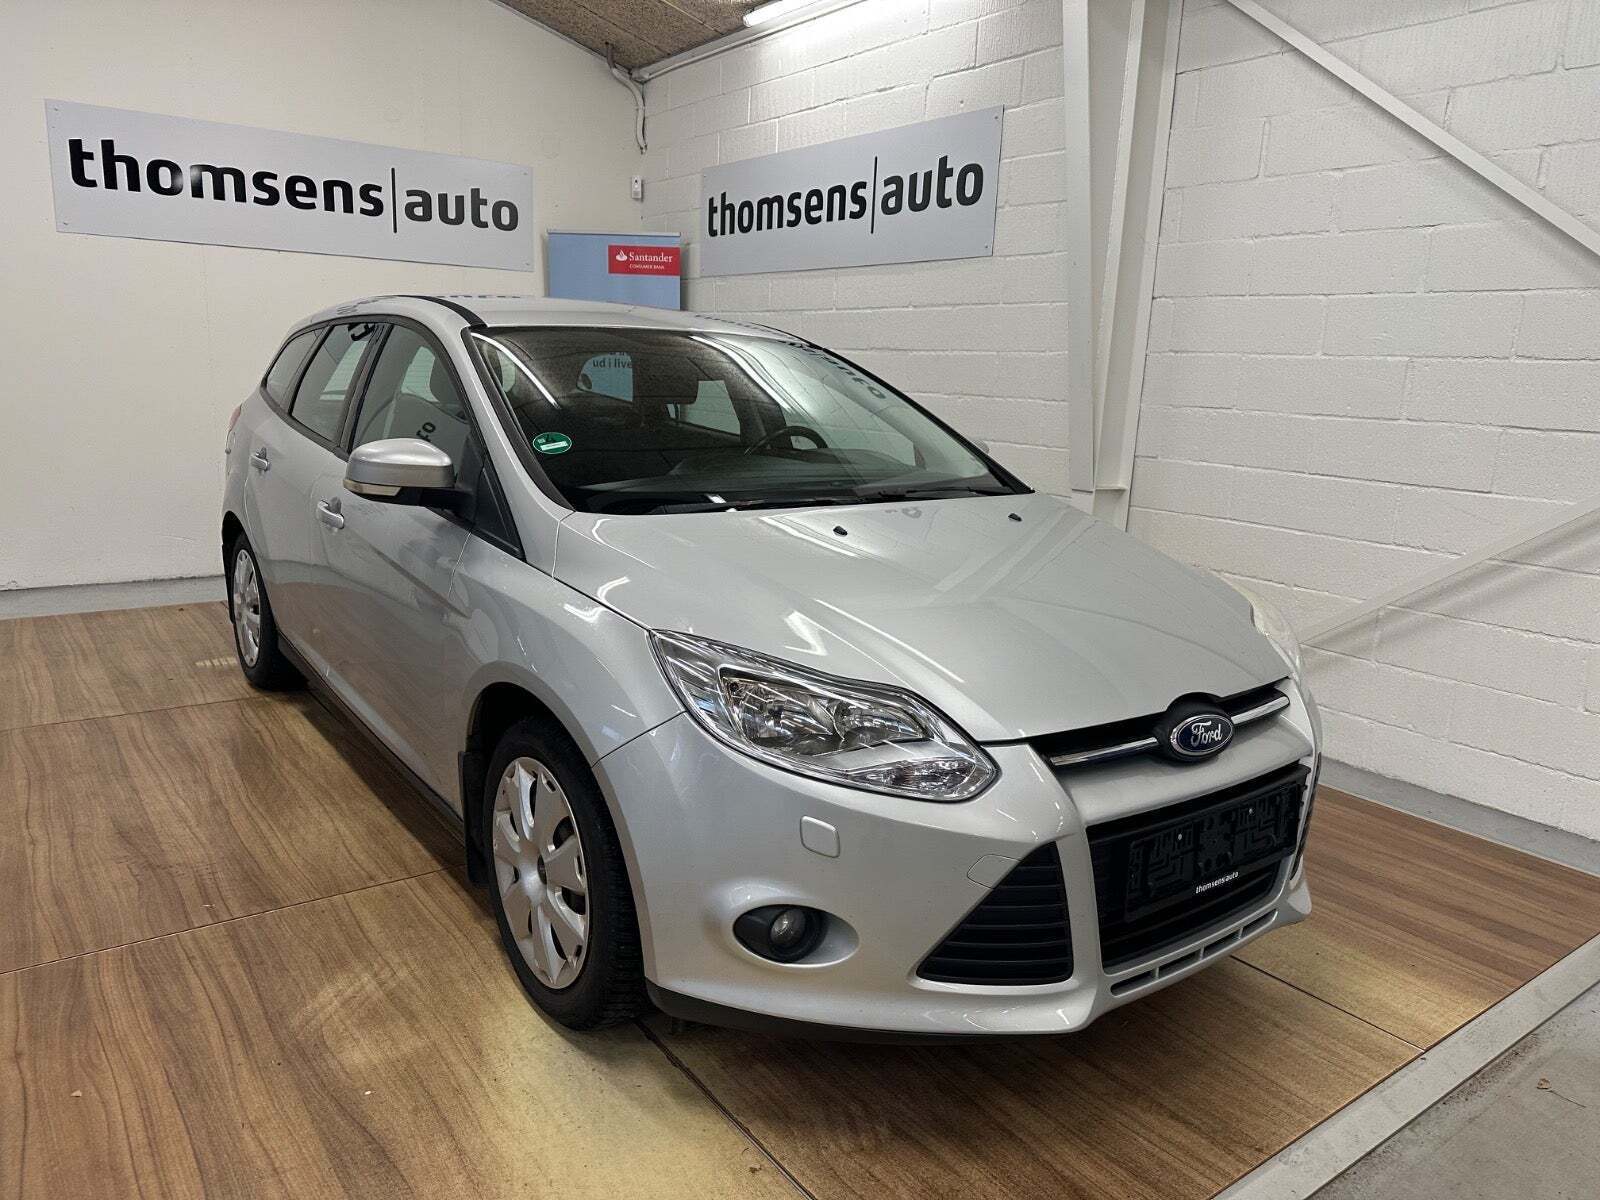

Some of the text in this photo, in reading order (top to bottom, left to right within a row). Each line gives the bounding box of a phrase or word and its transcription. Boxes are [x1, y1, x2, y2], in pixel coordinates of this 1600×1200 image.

[68, 138, 519, 231] thomsens auto
[708, 155, 984, 237] thomsens auto
[629, 251, 673, 262] Santander
[592, 357, 606, 368] ud
[1190, 720, 1223, 747] Ford
